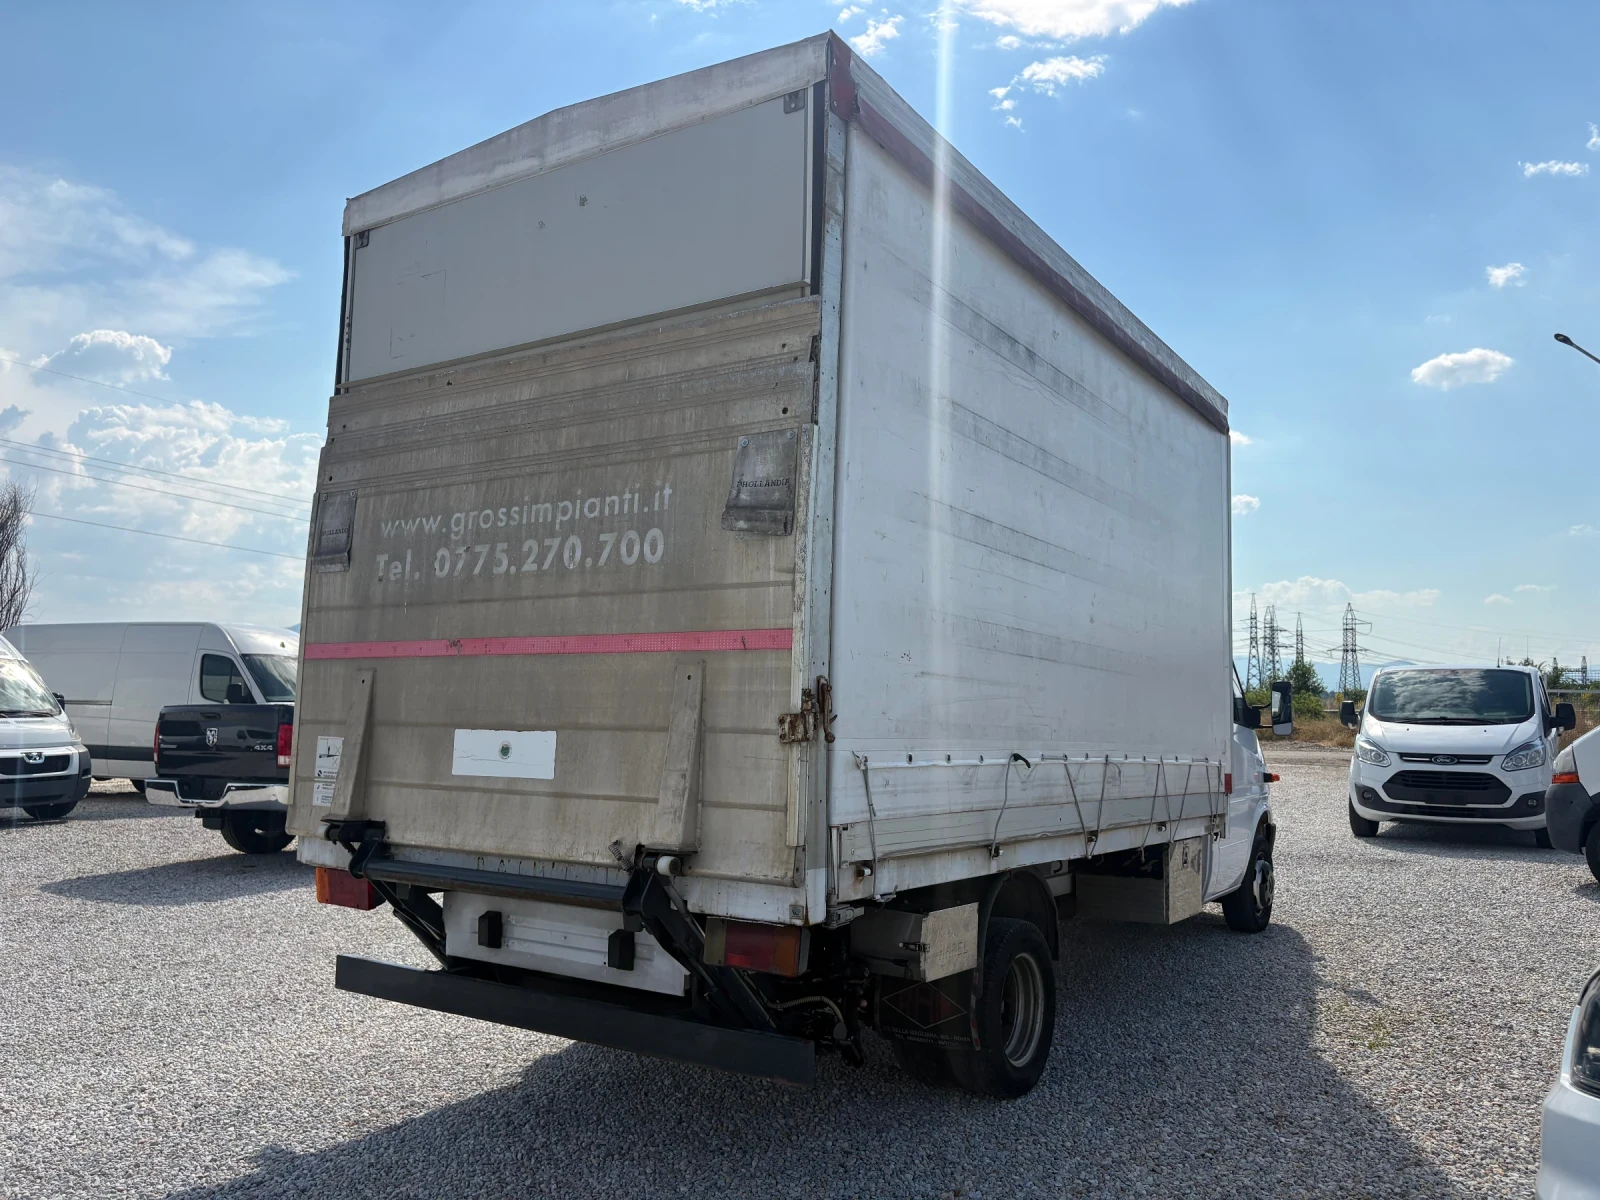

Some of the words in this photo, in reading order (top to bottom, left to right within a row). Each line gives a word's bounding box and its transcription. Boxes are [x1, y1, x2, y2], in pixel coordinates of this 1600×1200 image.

[379, 480, 673, 540] www.grossimpianti.it
[375, 548, 420, 582] Tel.
[433, 527, 665, 579] 0775.270.700
